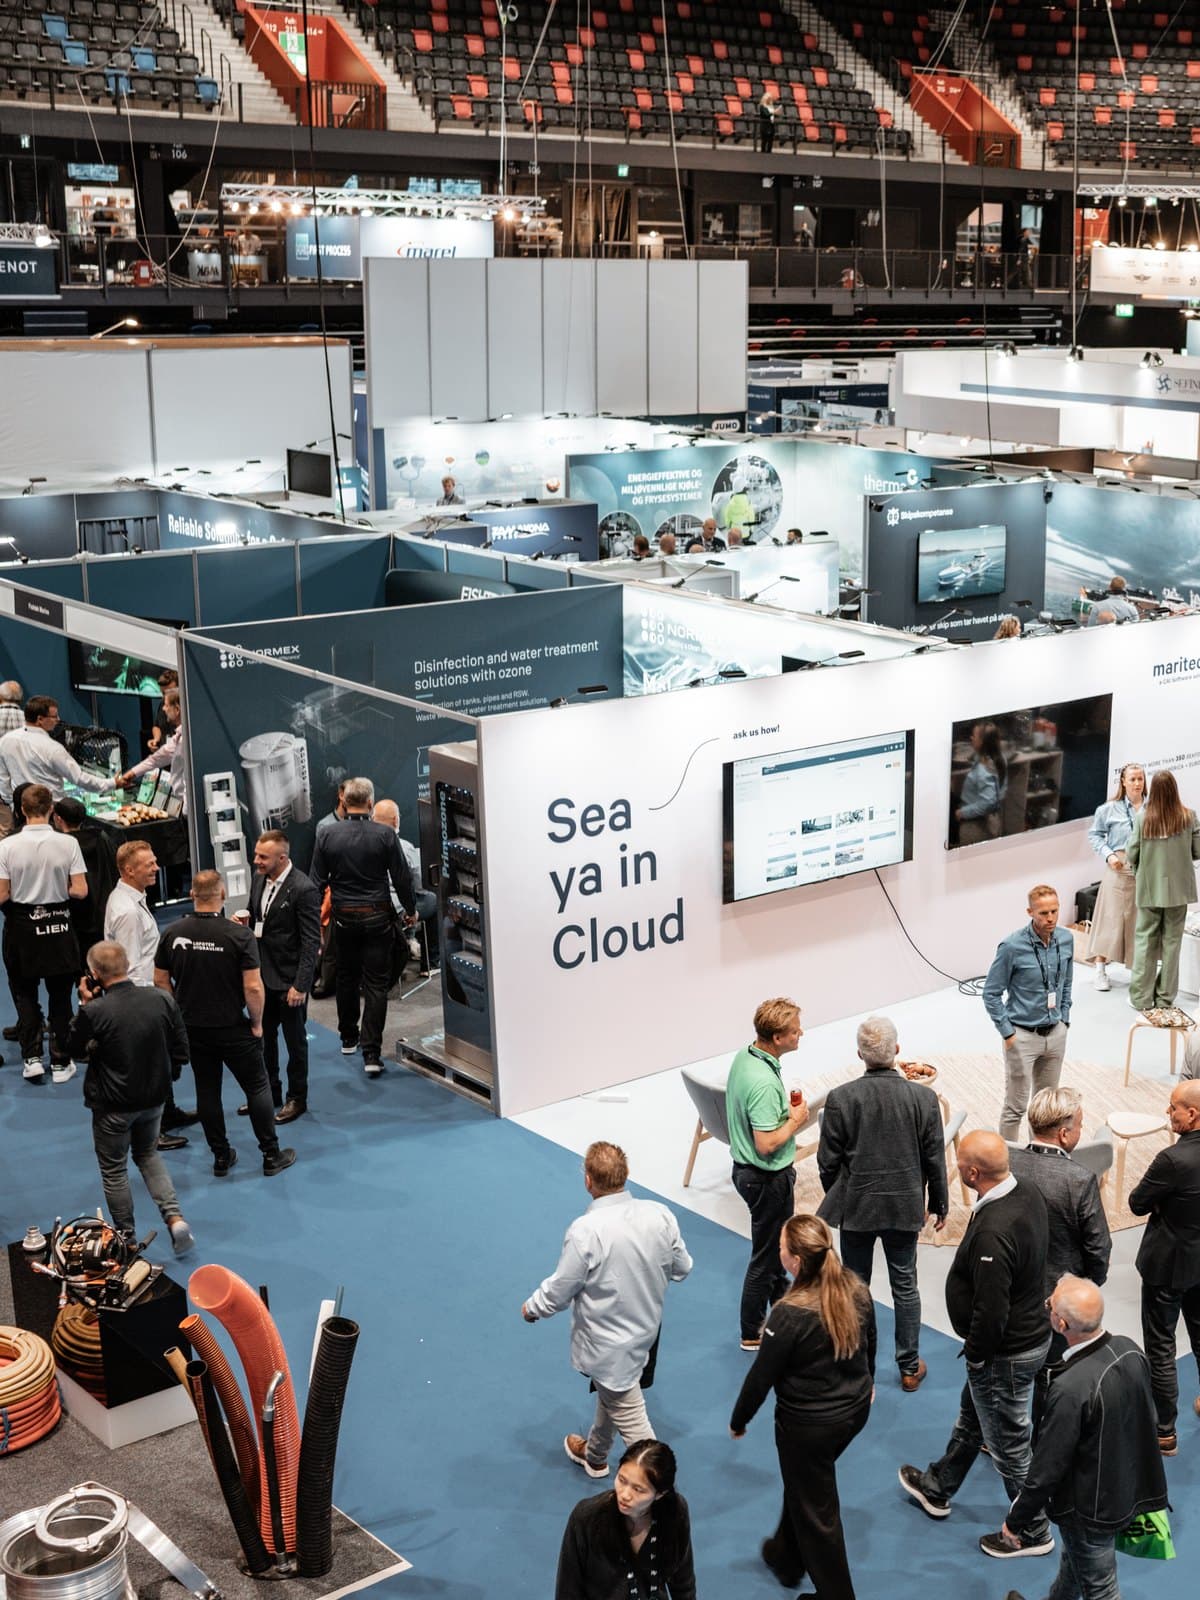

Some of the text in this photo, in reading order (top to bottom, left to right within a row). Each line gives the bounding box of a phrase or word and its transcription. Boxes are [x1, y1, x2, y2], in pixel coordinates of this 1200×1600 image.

[171, 149, 188, 160] 106
[406, 245, 457, 258] marel
[714, 422, 737, 431] JUMO
[691, 469, 703, 478] OG
[632, 495, 644, 506] OG
[168, 514, 204, 538] Reliable
[250, 645, 300, 658] ORMEX
[414, 640, 599, 675] Disinfection and water treatment
[414, 665, 533, 691] solutions with ozone
[483, 694, 500, 704] pipes
[500, 691, 513, 701] and
[415, 712, 436, 722] Waste
[469, 704, 486, 714] water
[487, 701, 519, 711] treatment
[733, 724, 780, 740] ask us how!
[547, 797, 632, 844] Sea
[439, 790, 450, 879] Primozone
[549, 843, 657, 914] ya in
[35, 923, 69, 936] LIEN
[552, 897, 684, 970] Cloud
